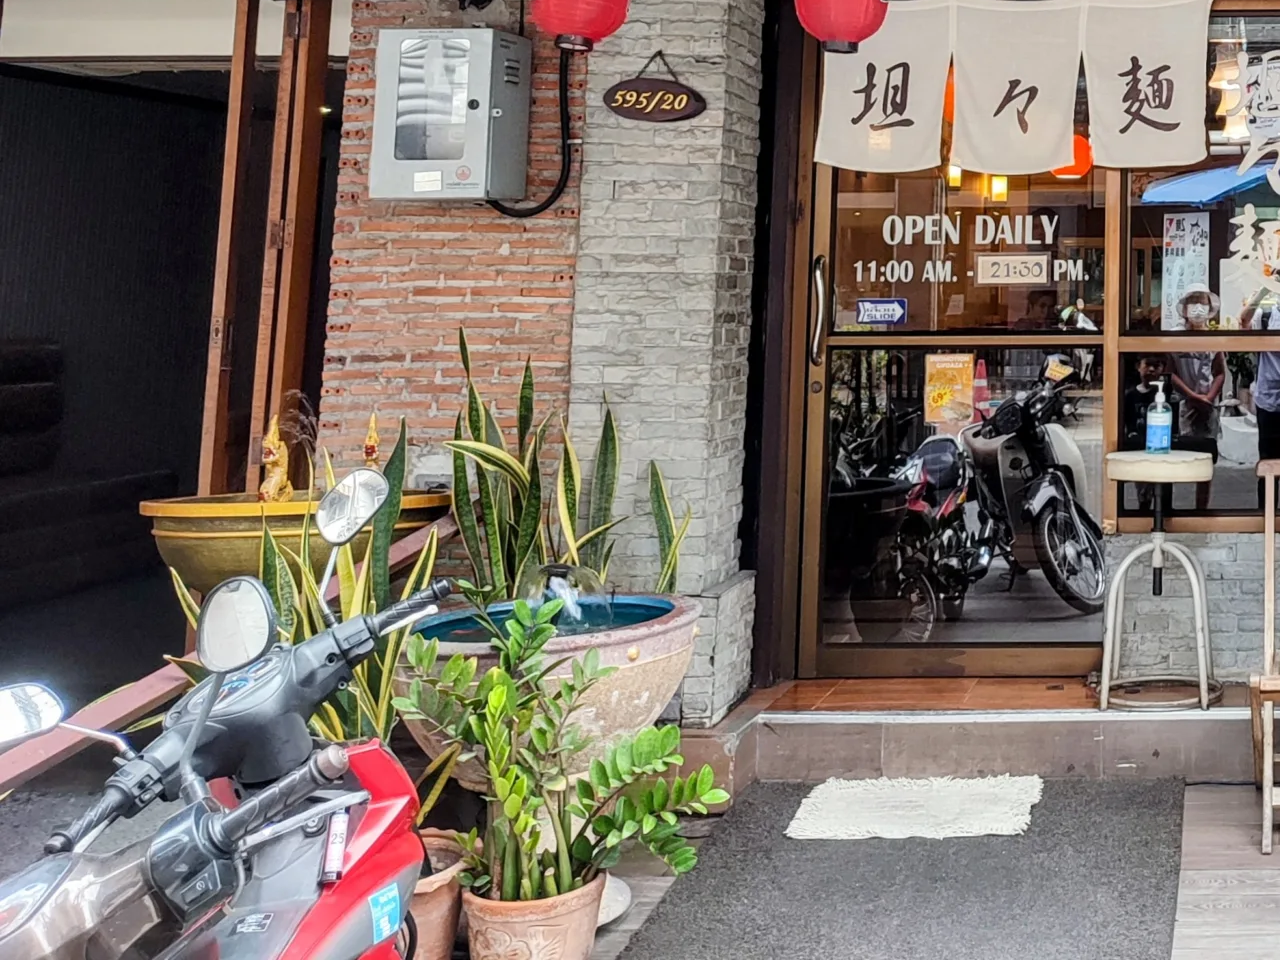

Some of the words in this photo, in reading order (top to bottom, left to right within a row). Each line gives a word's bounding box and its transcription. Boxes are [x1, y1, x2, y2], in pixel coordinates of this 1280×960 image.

[611, 90, 688, 114] 595/20
[882, 214, 960, 246] OPEN
[975, 214, 1059, 245] DAILY
[853, 260, 914, 283] 11:00
[921, 261, 958, 282] AM.
[990, 261, 1043, 279] 21:30
[1053, 259, 1090, 281] PM.
[866, 312, 896, 320] SLIDE
